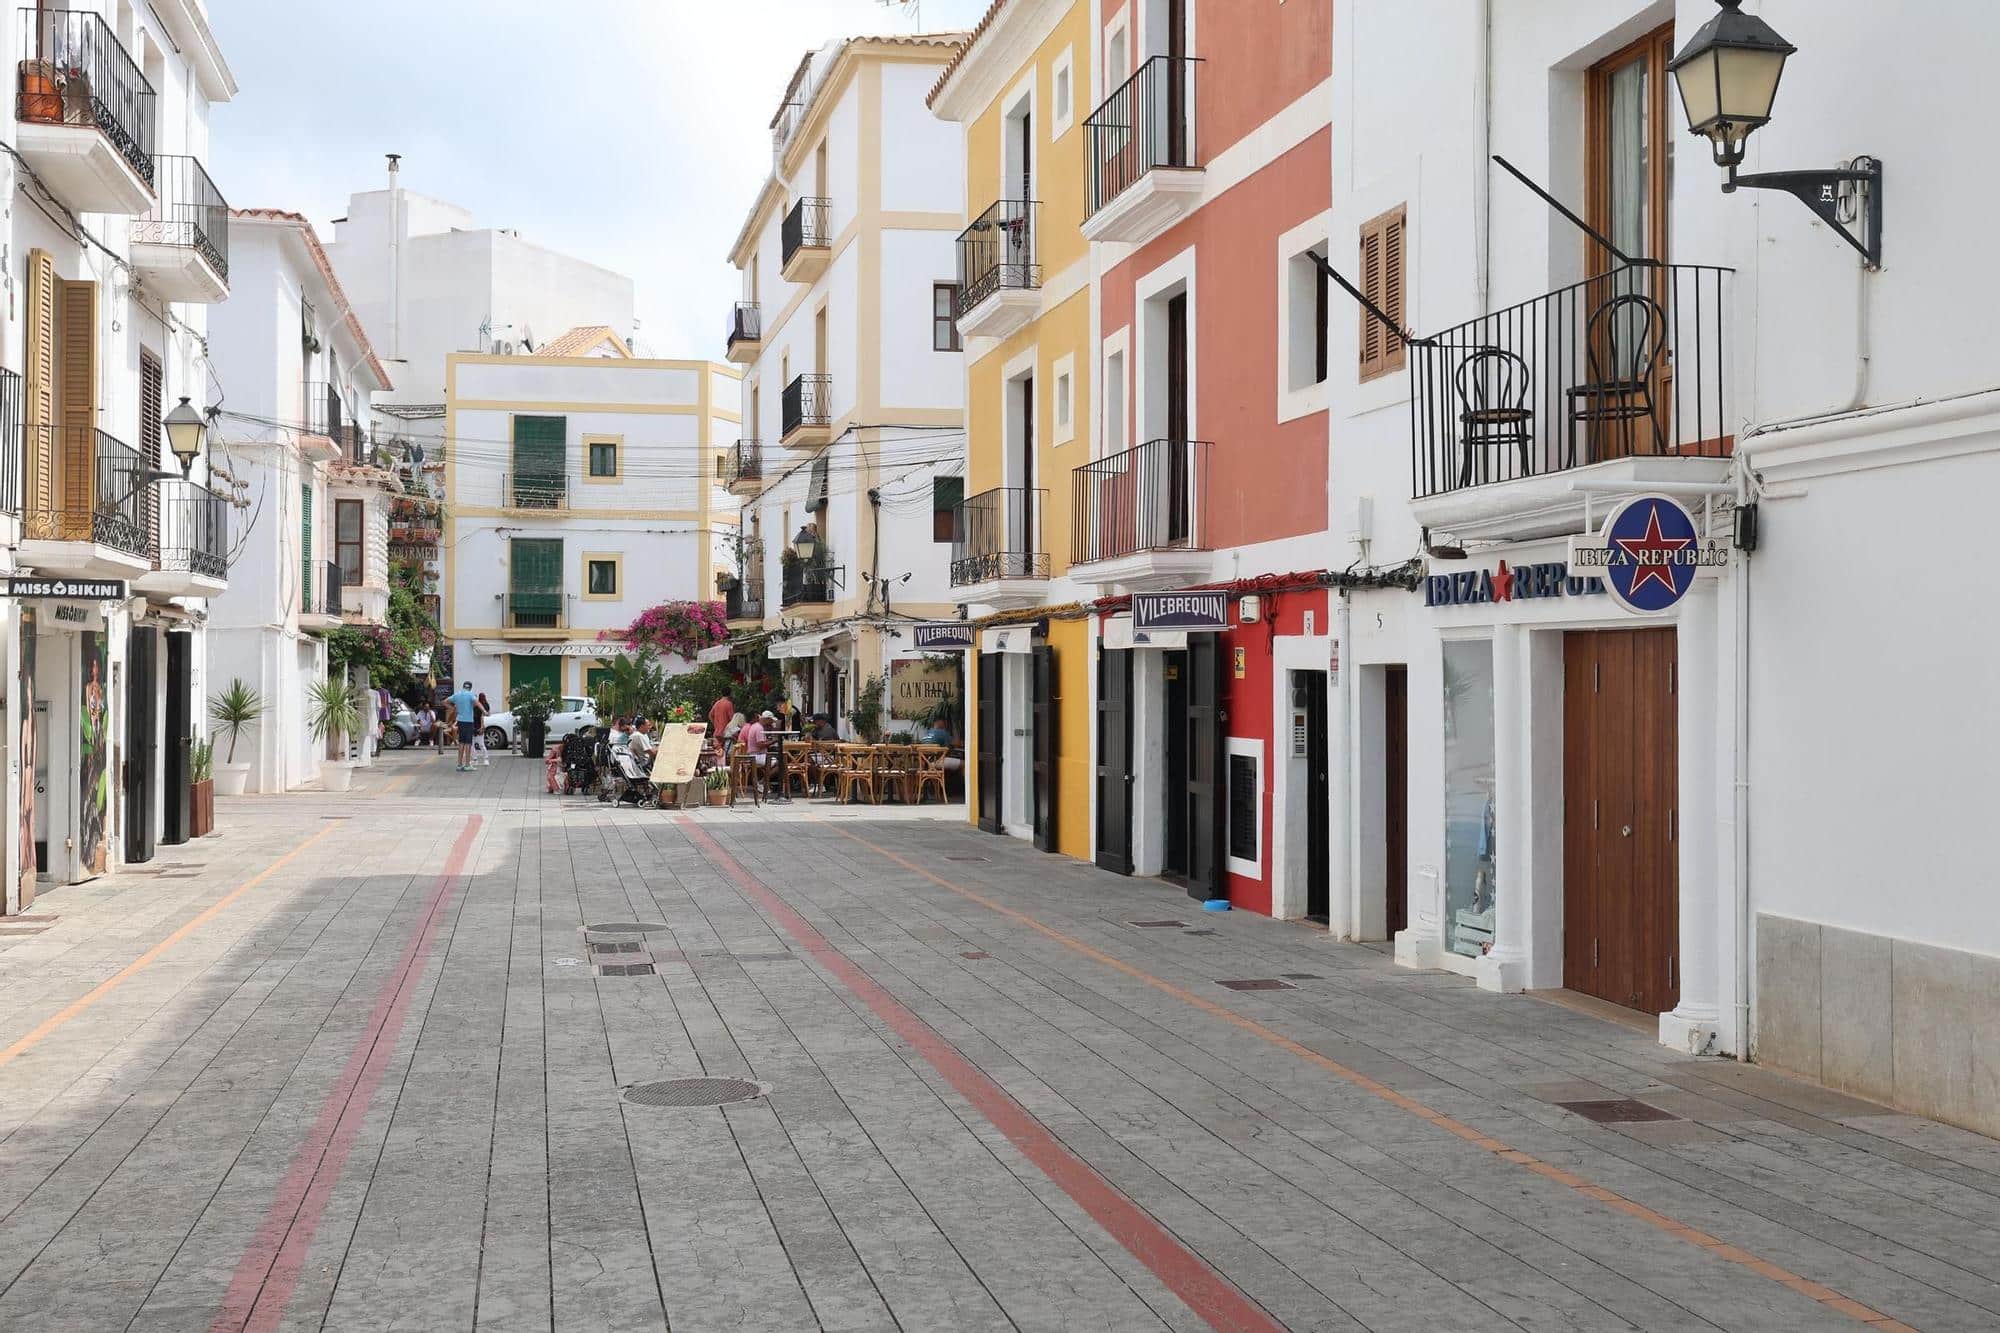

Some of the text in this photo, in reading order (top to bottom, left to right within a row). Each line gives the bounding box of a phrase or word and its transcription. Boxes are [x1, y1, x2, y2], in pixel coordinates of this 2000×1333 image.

[1575, 541, 1728, 567] IBIZA REPUBLIC
[13, 583, 118, 597] MISS BIKINI
[1424, 569, 1493, 607] IBIZA
[1137, 596, 1224, 625] VILEBREQUIN
[1376, 612, 1384, 629] 5
[916, 626, 974, 646] VILEBREQUIN
[900, 682, 921, 698] CA'N
